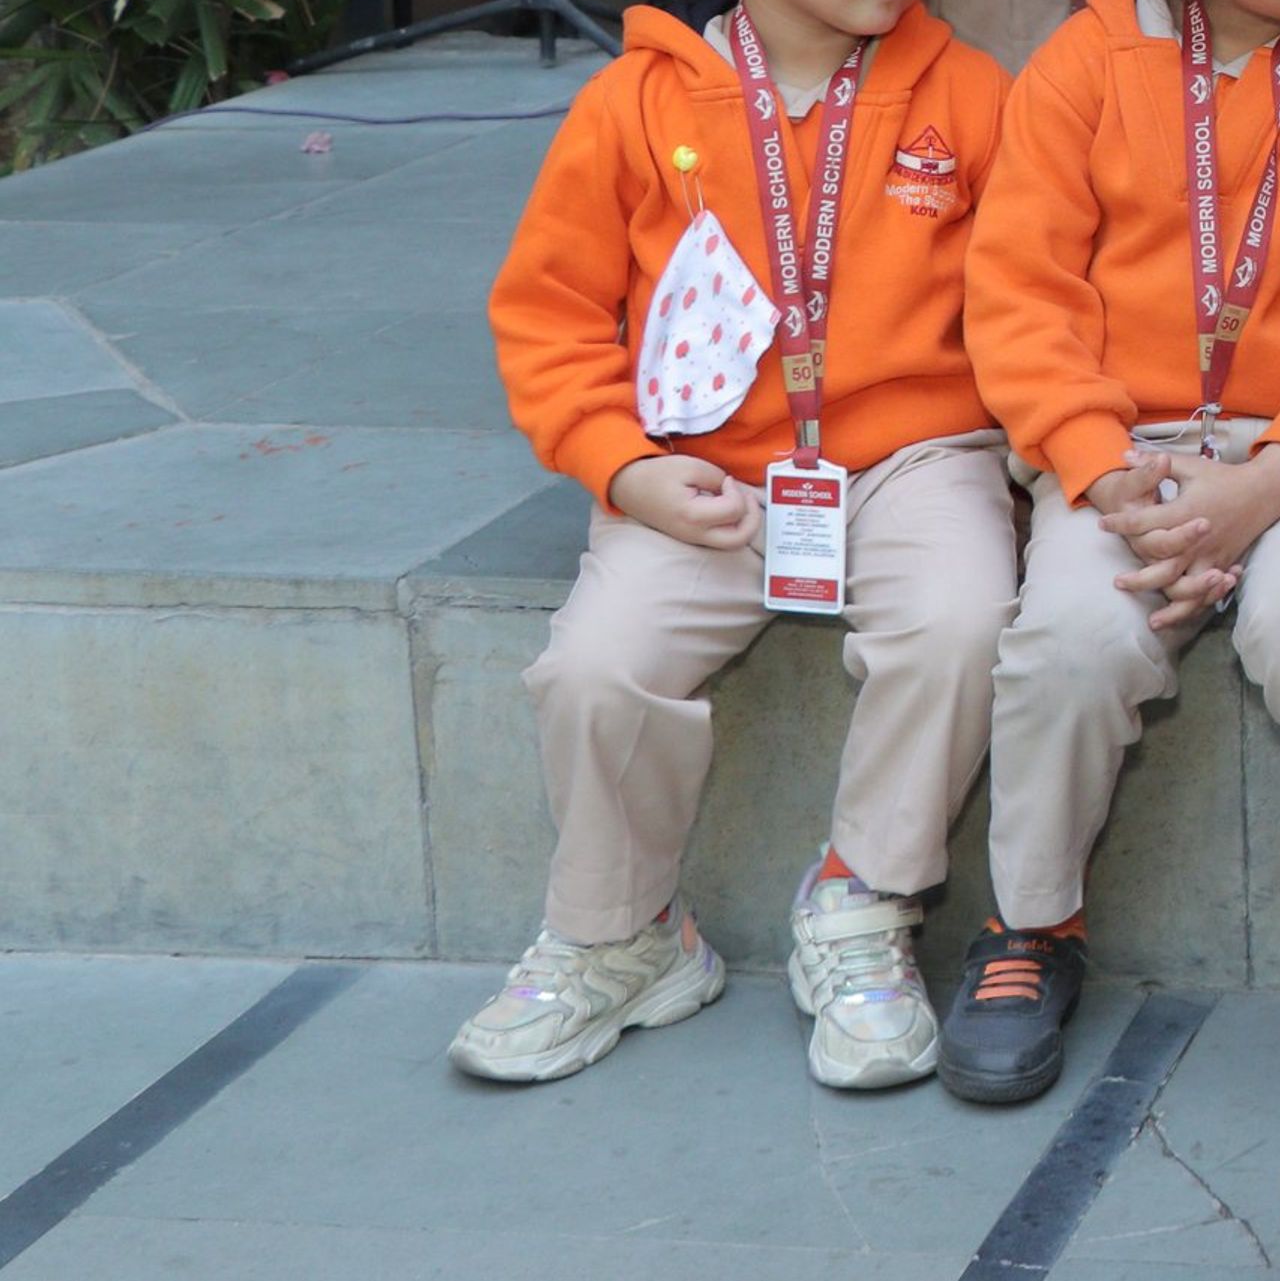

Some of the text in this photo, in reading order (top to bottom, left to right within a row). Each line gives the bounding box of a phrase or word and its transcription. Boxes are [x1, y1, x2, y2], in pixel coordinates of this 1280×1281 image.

[736, 16, 766, 79] MODERN
[1191, 0, 1206, 65] MODERN
[763, 130, 799, 295] MODERN SCHOOL
[812, 118, 847, 280] MODERN SCHOOL
[911, 206, 938, 218] KOTA
[1196, 116, 1217, 274] MODERN SCHOOL
[1246, 164, 1277, 249] MODERN
[1220, 315, 1240, 332] 50
[791, 365, 812, 381] 50
